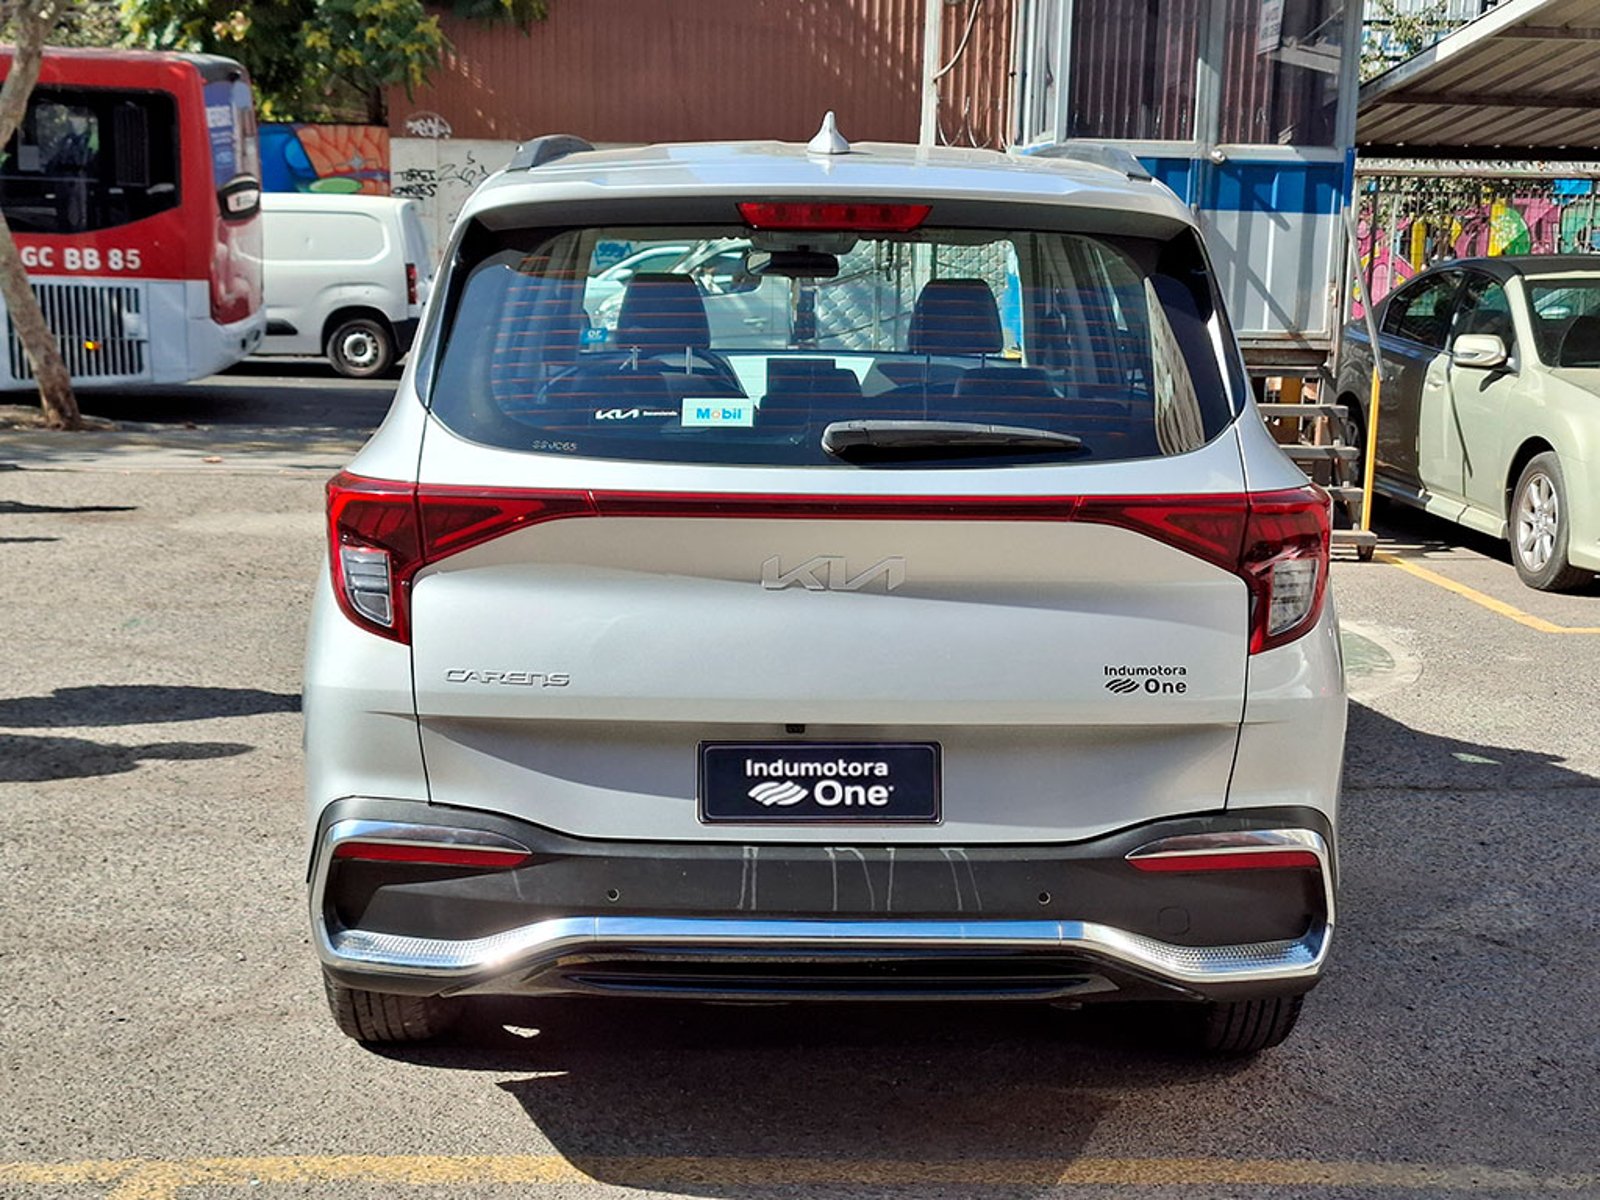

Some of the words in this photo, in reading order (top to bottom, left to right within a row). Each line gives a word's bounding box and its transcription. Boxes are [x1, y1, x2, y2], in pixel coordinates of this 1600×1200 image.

[21, 246, 54, 267] GC
[64, 248, 101, 270] BB
[108, 248, 141, 270] 85
[696, 408, 742, 420] Mobil
[761, 554, 907, 592] KIA
[1104, 665, 1187, 676] Indumotora
[1144, 678, 1187, 694] One
[746, 759, 889, 777] Indumotora
[813, 779, 889, 806] One
